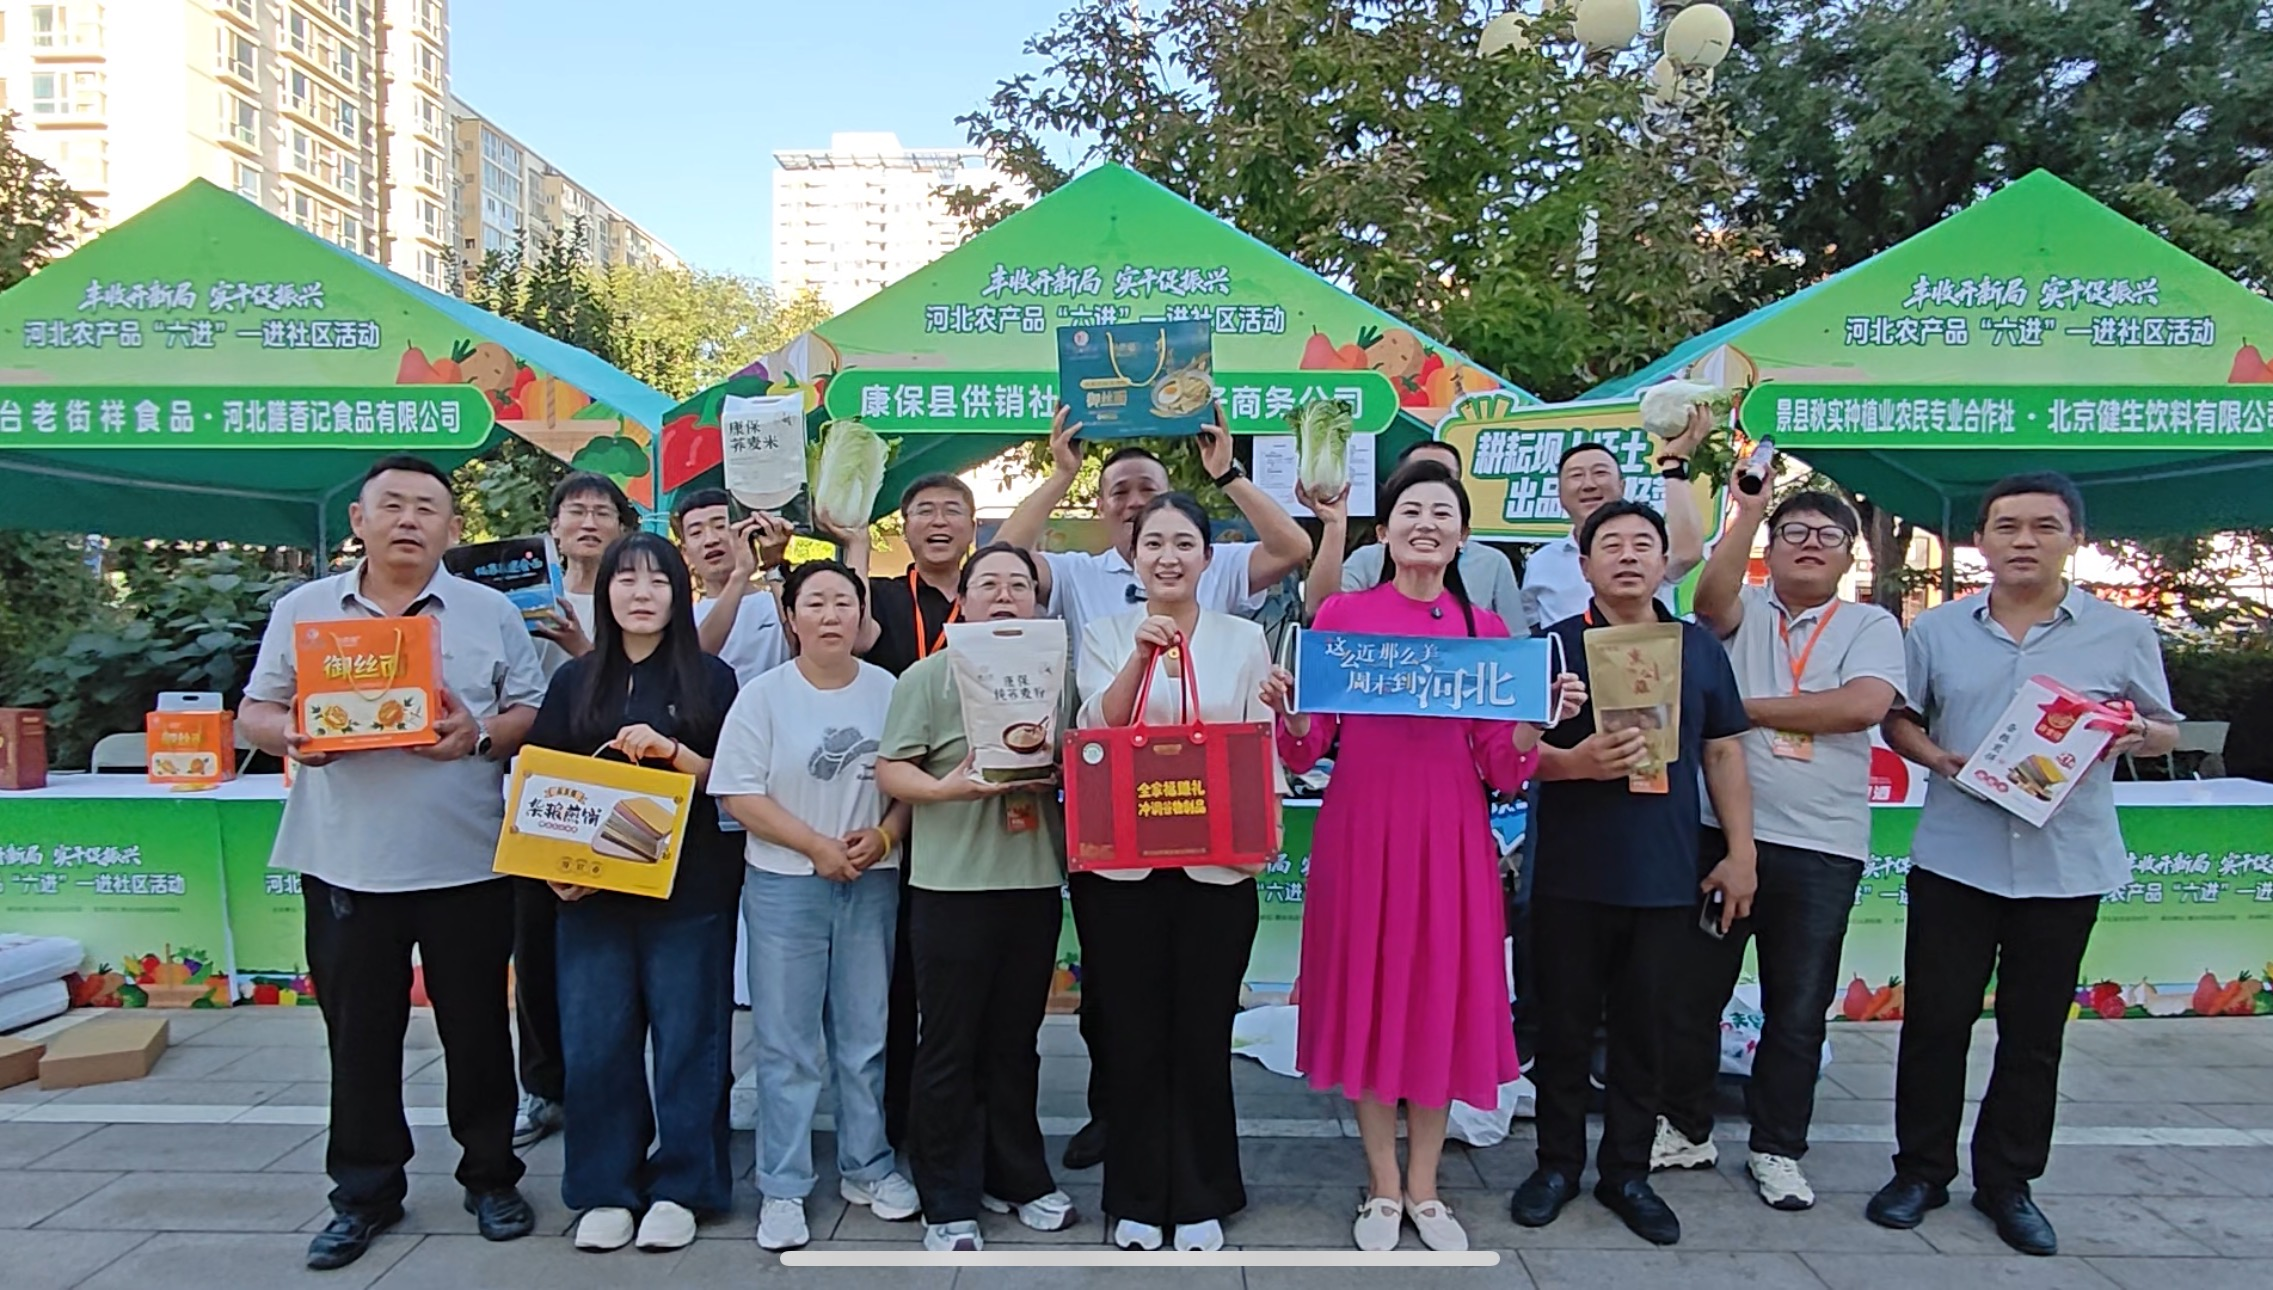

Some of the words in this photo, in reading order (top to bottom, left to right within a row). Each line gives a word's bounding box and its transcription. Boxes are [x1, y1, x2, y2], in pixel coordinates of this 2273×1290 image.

[78, 279, 197, 313] 丰收开新局
[208, 280, 325, 312] 实干促振兴
[982, 264, 1101, 297] 丰收开新局
[1113, 264, 1231, 297] 实干促振兴
[1903, 275, 2027, 309] 丰收开新局
[2039, 276, 2159, 309] 实干促振兴
[861, 384, 1059, 418] 康保县供销社
[1473, 430, 1647, 474] 耕耘坝土
[1347, 662, 1516, 709] 周末到河北
[0, 844, 43, 868] 新局
